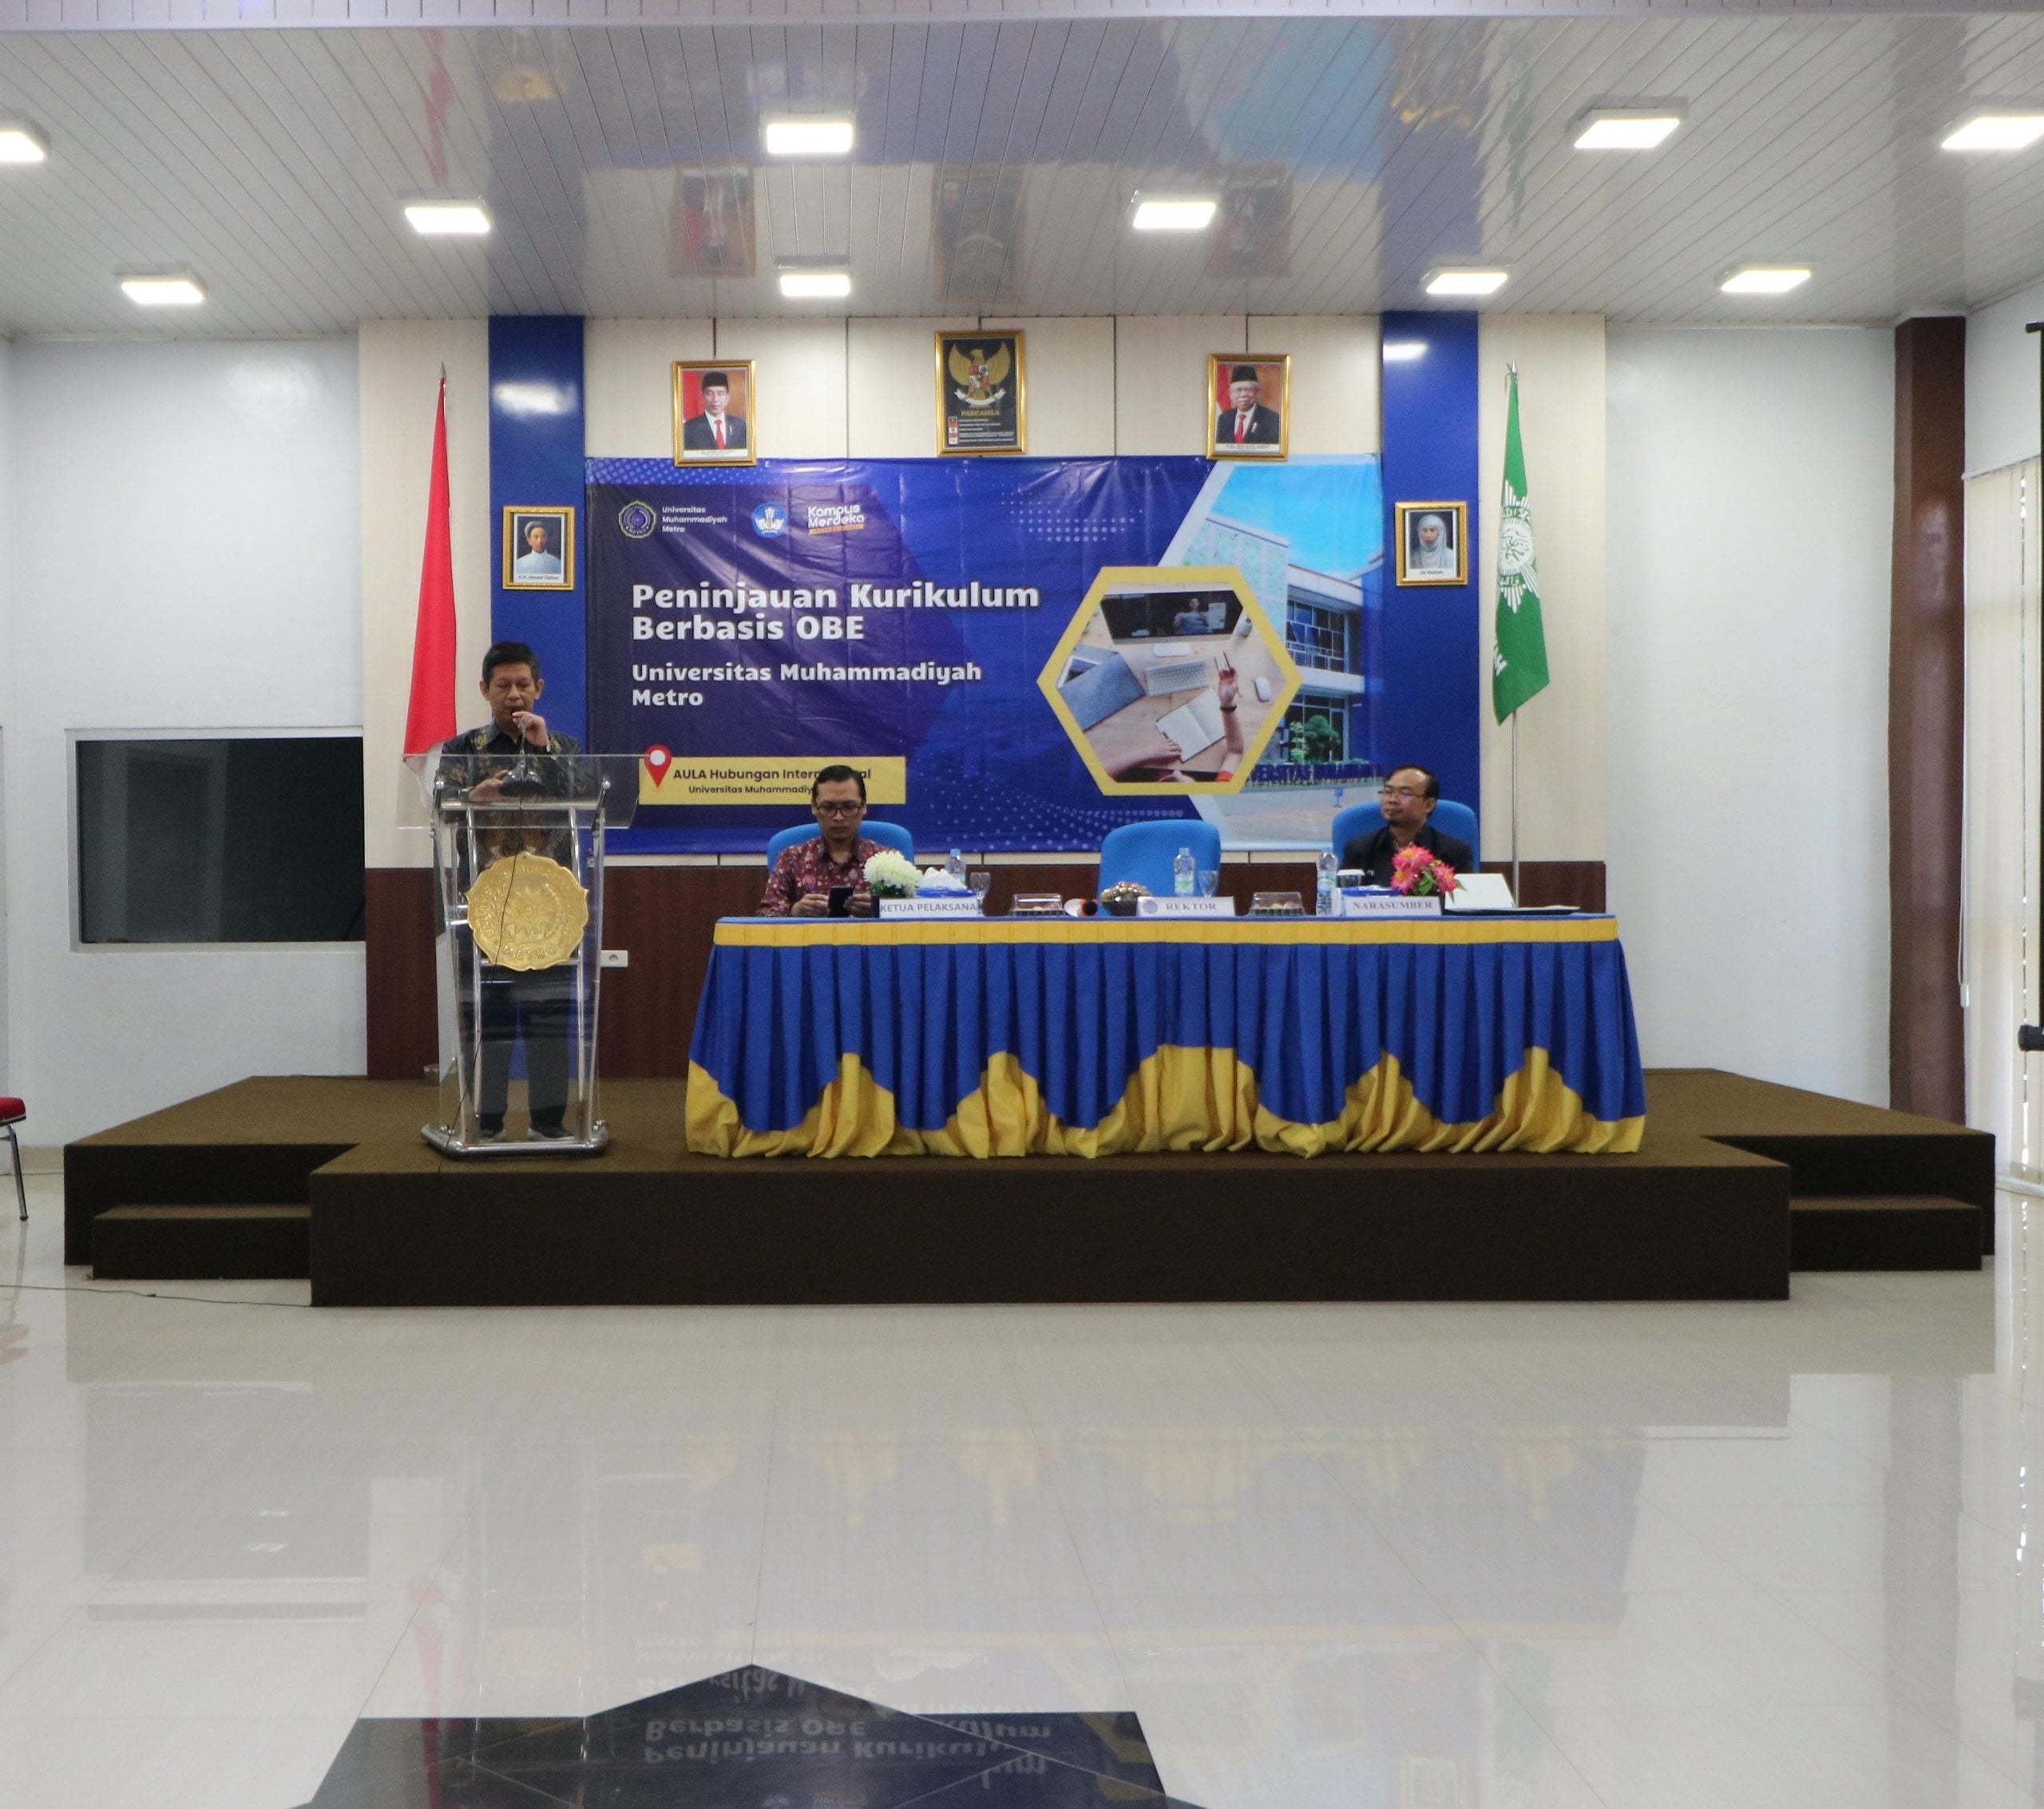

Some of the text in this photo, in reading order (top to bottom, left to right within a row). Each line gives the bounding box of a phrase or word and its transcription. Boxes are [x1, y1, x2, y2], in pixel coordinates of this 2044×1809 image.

[808, 505, 860, 519] Kampus
[662, 516, 727, 524] Muhammadiyah
[808, 514, 865, 528] Merdeka
[632, 581, 1039, 614] Peninjauan Kurikulum
[632, 613, 865, 640] Berbasis OBE
[632, 661, 982, 686] Universitas Muhammadiyah
[632, 689, 703, 706] Metro
[673, 769, 707, 779] AULA
[710, 768, 780, 782] Hubungan
[881, 902, 977, 912] KETUA PELAKSANA
